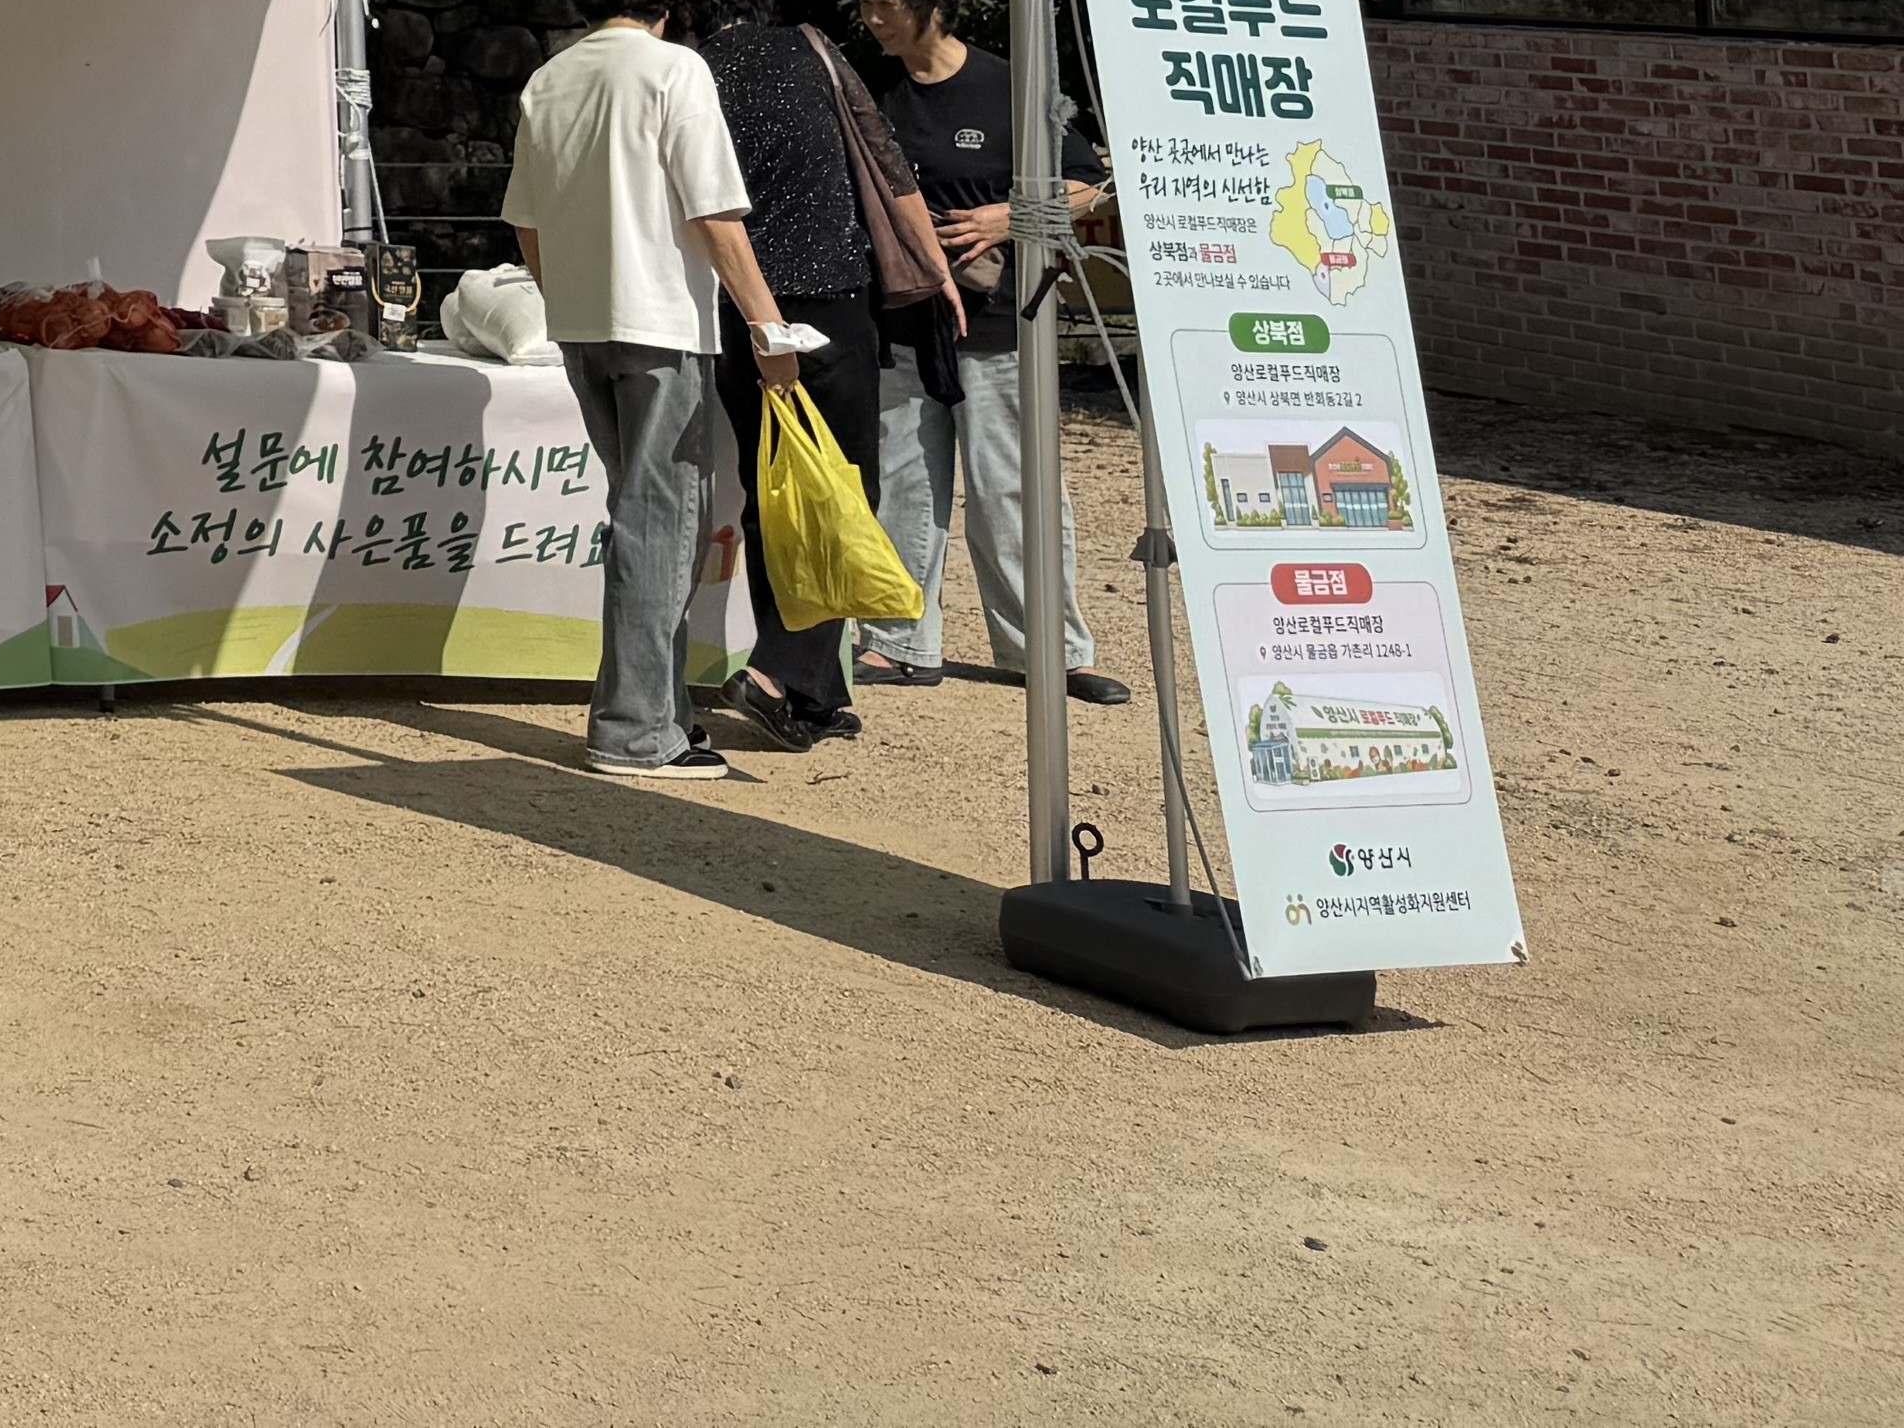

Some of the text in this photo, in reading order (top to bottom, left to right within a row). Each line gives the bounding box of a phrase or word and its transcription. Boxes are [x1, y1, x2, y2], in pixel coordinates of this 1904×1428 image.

[1162, 50, 1314, 120] 직매장
[1132, 136, 1270, 168] 양산 곳곳에서 만나는
[1138, 172, 1273, 206] 우리 지역의 신선함
[1252, 319, 1306, 346] 상북점
[200, 427, 592, 496] 설문에 참여하시면
[146, 507, 283, 565] 소정의
[303, 510, 478, 574] 사은품을
[1294, 569, 1348, 596] 물금점
[1357, 846, 1412, 871] 양산시
[1316, 890, 1472, 920] 양산시지역활성화지원센터
